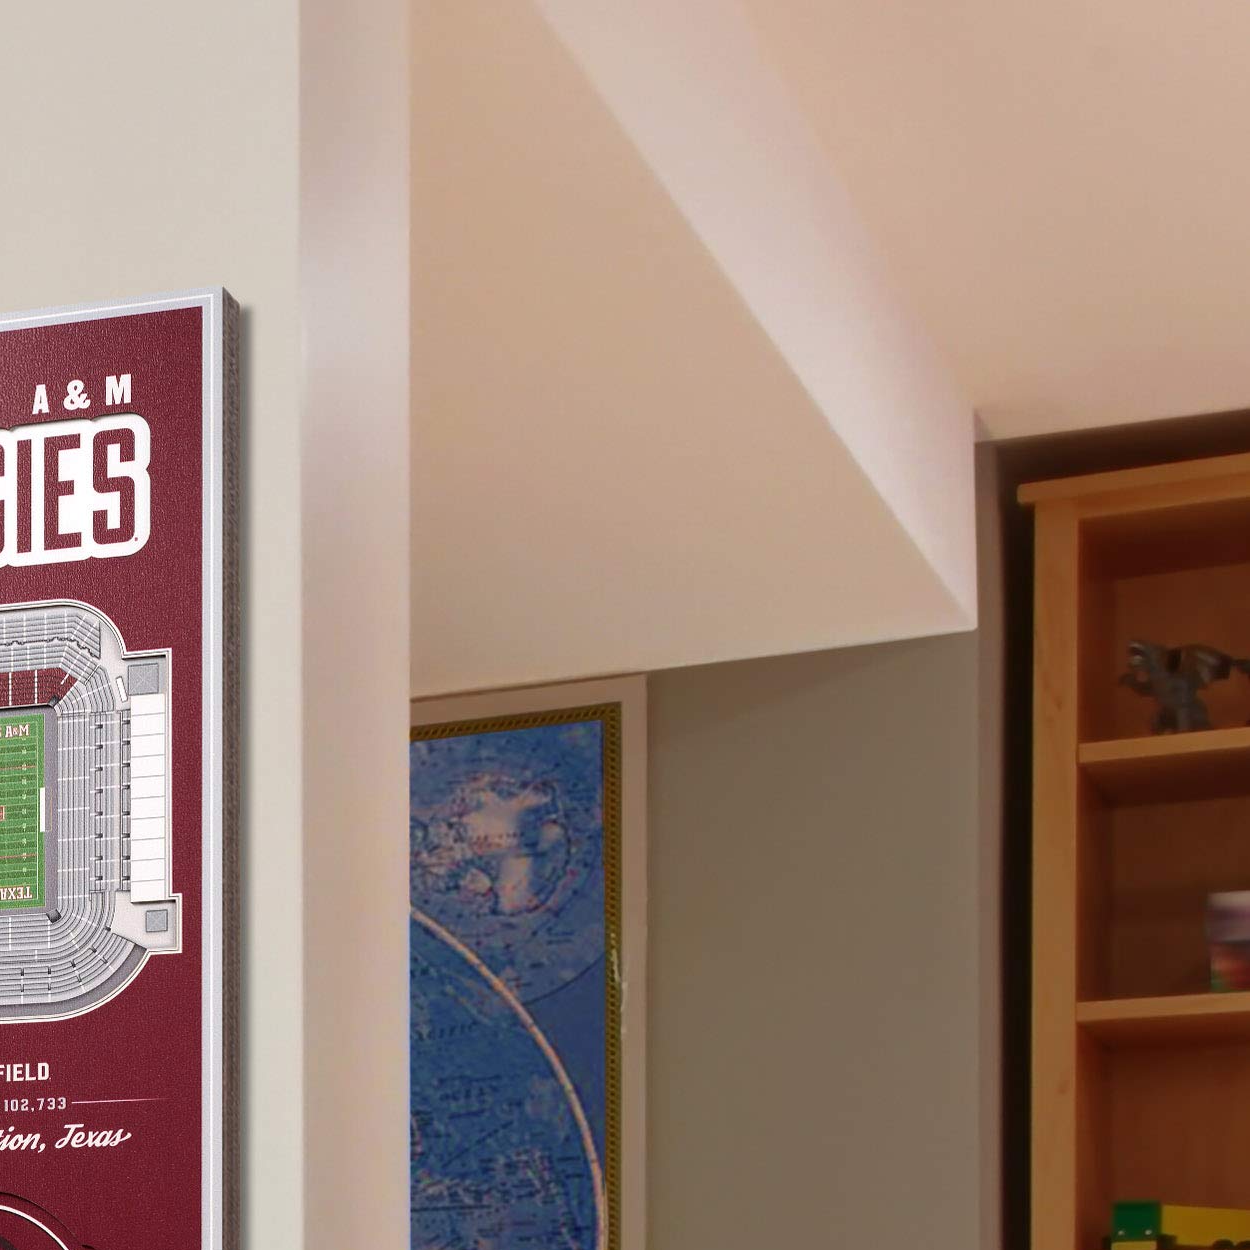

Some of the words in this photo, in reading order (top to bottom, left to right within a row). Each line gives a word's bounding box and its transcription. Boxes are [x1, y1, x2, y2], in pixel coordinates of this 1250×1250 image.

[32, 374, 132, 411] A&M
[5, 723, 30, 738] A&M
[4, 1096, 67, 1113] 102,733
[54, 1123, 132, 1149] Texas
